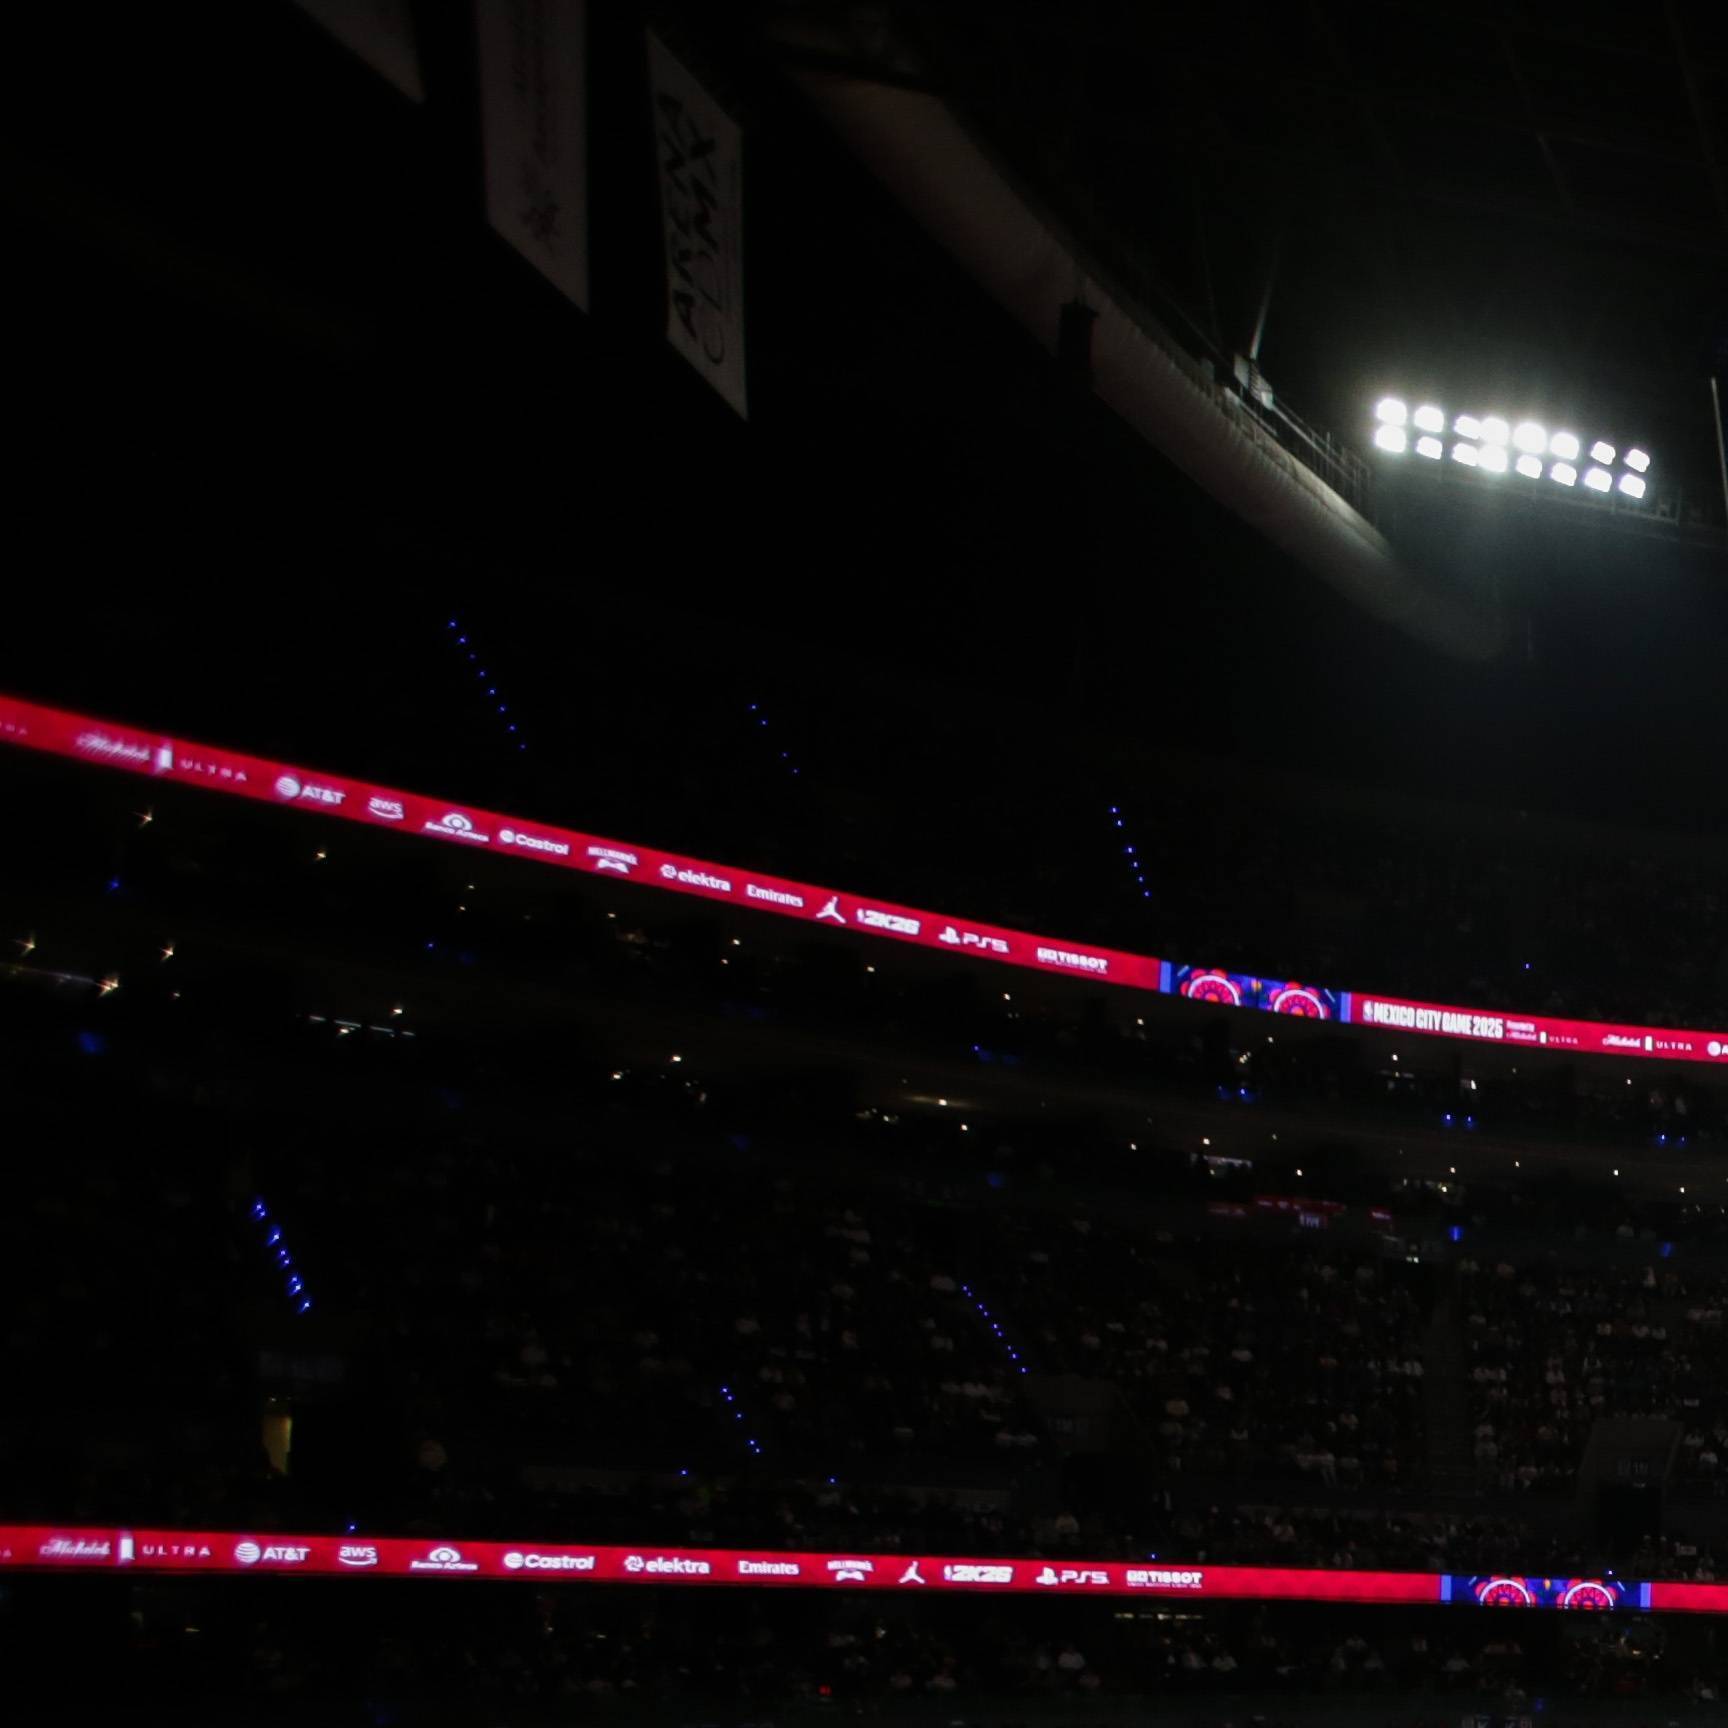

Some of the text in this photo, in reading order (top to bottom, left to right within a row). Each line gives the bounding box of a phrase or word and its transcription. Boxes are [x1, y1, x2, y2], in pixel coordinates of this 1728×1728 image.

[302, 785, 345, 804] AT&T
[516, 833, 568, 855] Castrol
[678, 870, 730, 891] elektra
[746, 883, 803, 907] Emirates
[963, 933, 1009, 953] PS5
[1374, 1002, 1415, 1027] MEXICO
[1416, 1006, 1441, 1030] CITY
[1442, 1010, 1471, 1035] GAME
[1472, 1014, 1503, 1038] 2025
[142, 1545, 210, 1557] ULTRA
[263, 1547, 311, 1561] AT&T
[340, 1546, 376, 1557] aws
[526, 1553, 595, 1570] Castrol
[646, 1557, 709, 1574] elektra
[739, 1560, 799, 1575] Emirates
[1062, 1570, 1109, 1584] PS5
